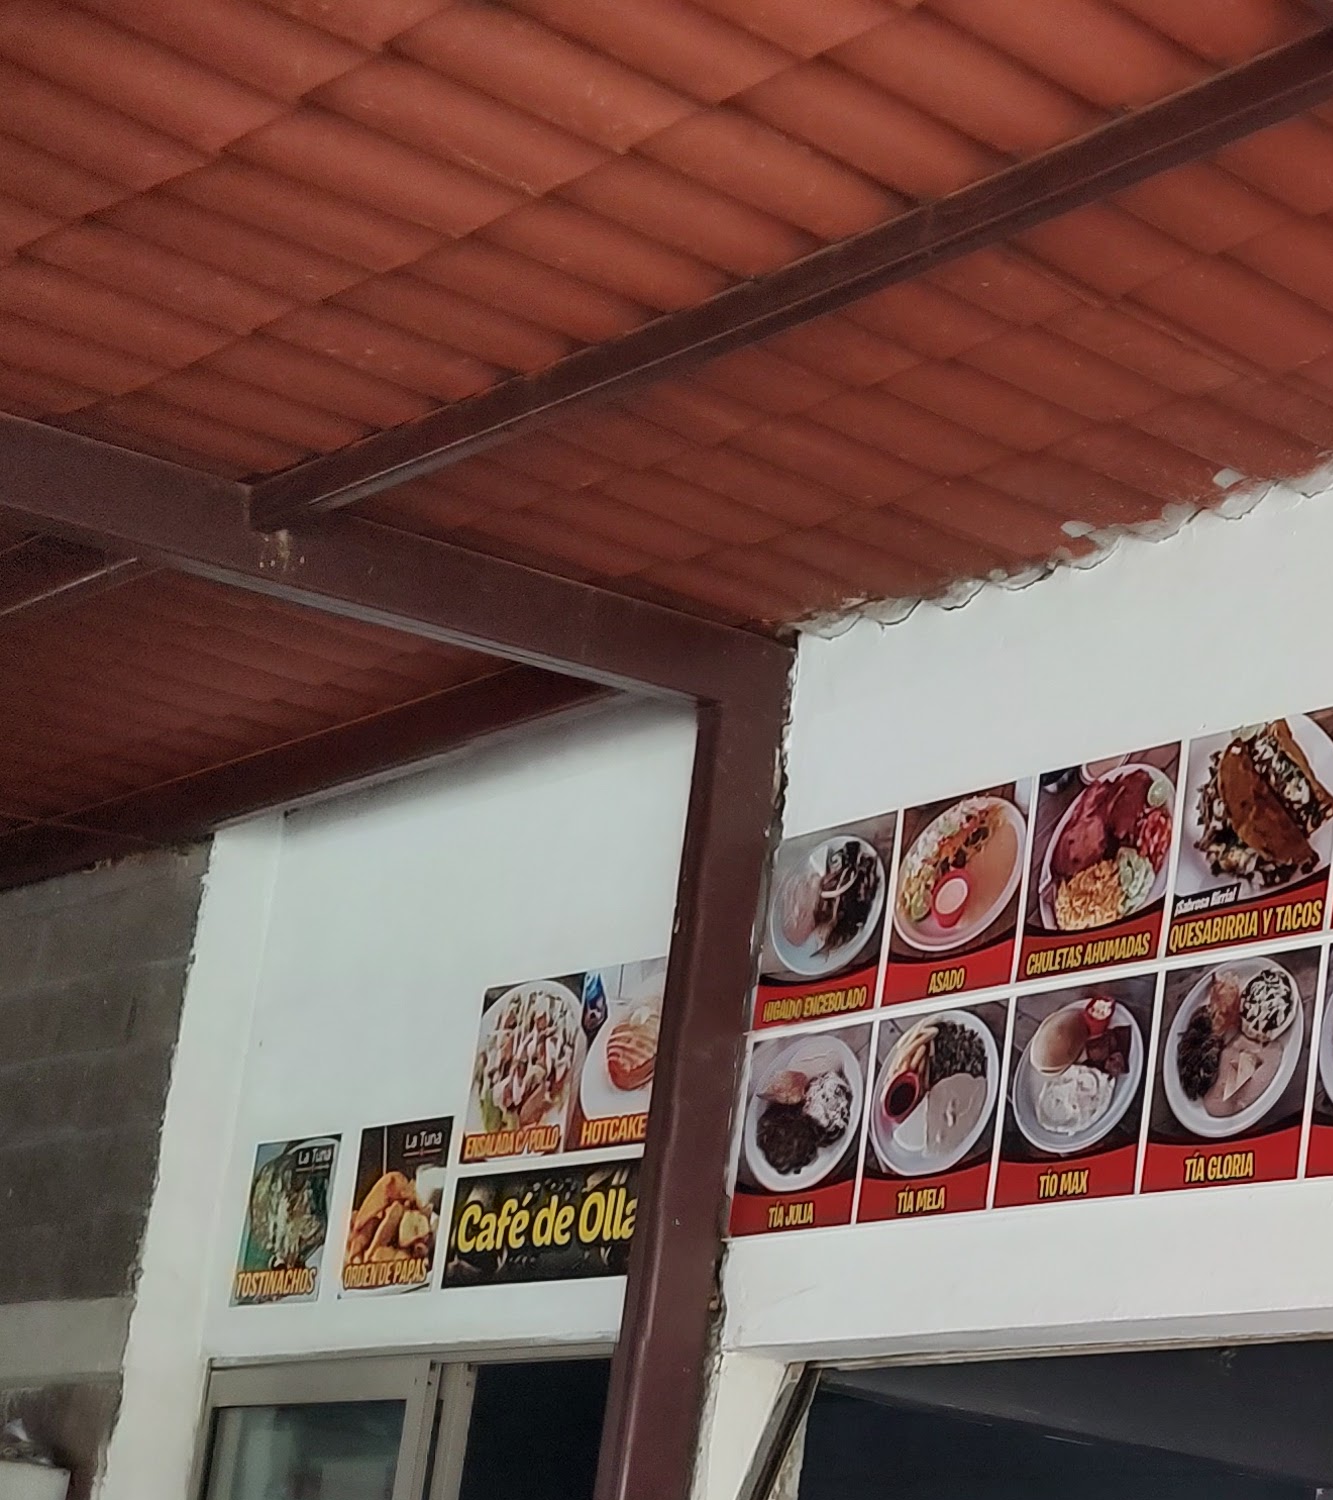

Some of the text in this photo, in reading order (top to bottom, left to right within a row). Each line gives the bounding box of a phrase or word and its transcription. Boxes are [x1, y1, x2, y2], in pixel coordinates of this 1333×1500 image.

[1168, 899, 1323, 953] QUESABIRRIA Y TACOS
[1026, 931, 1151, 976] CHULETAS AHUMADAS
[927, 968, 966, 994] ASADO
[803, 985, 867, 1018] ENCEBOLADO
[405, 1130, 443, 1149] La Tuna
[463, 1131, 515, 1160] ENSALADA
[298, 1147, 332, 1166] La Tuna
[1184, 1151, 1255, 1183] TÍA GLORIA
[1038, 1168, 1089, 1198] TÍO MAX
[896, 1183, 946, 1214] TÍA MELA
[456, 1191, 531, 1254] Café
[531, 1194, 576, 1248] de
[767, 1200, 814, 1229] TÍA JULIA
[235, 1267, 317, 1297] TOSTINACHOS
[343, 1258, 429, 1289] ORDEN DE PAPAS
